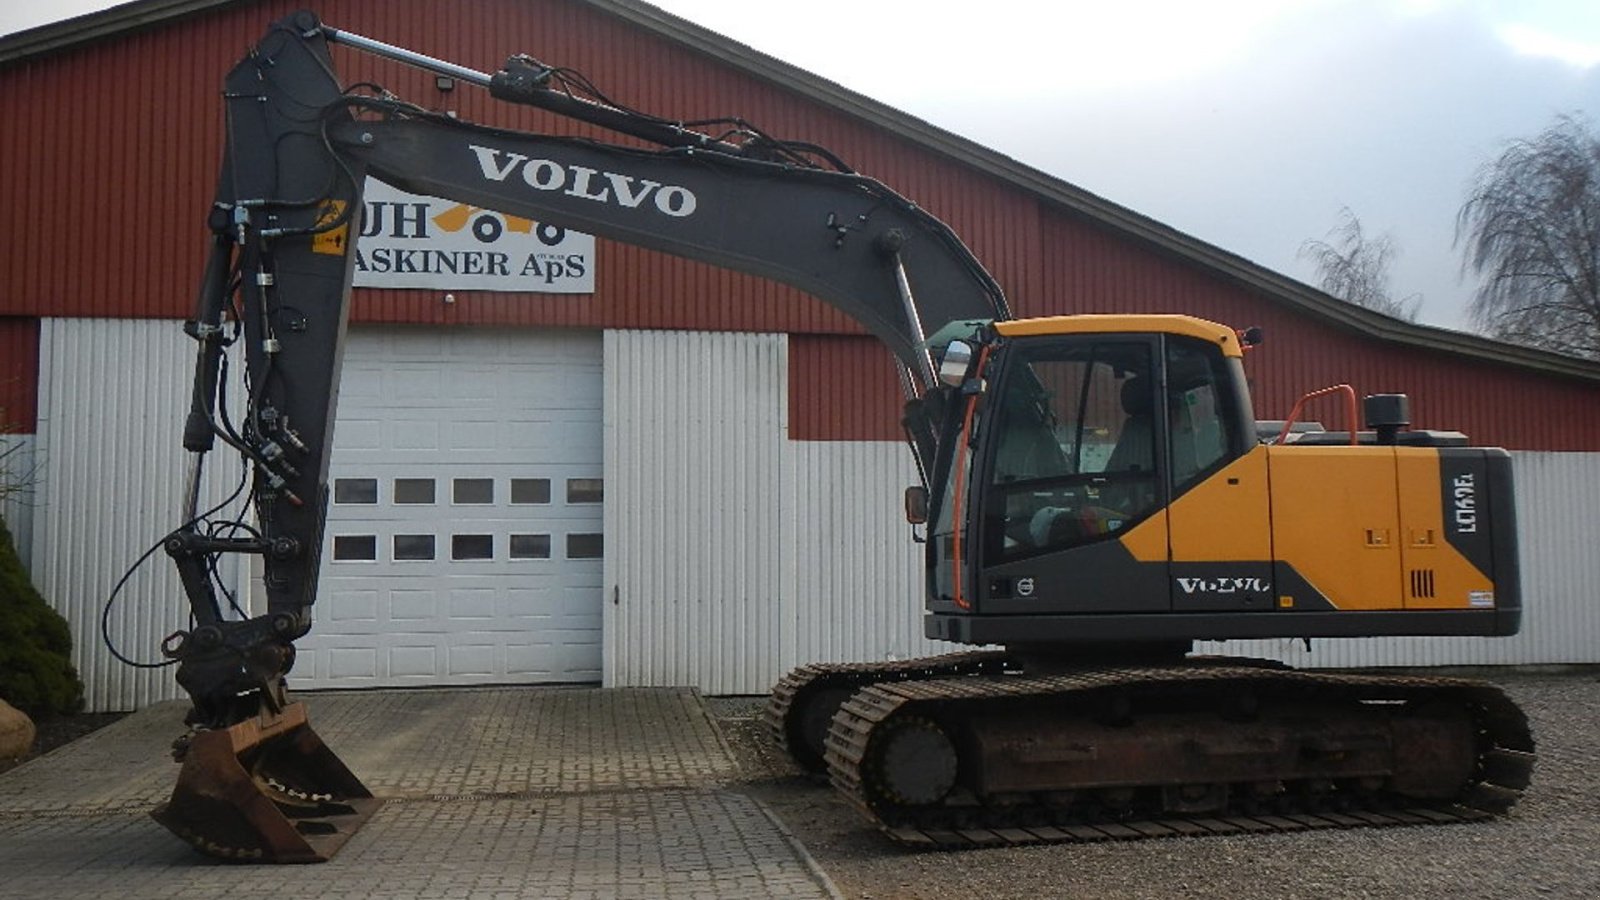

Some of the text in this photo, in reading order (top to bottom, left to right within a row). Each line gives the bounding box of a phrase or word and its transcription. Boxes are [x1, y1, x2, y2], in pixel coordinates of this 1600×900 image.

[469, 144, 697, 218] VOLVO
[360, 201, 431, 239] JH
[519, 253, 586, 284] ApS
